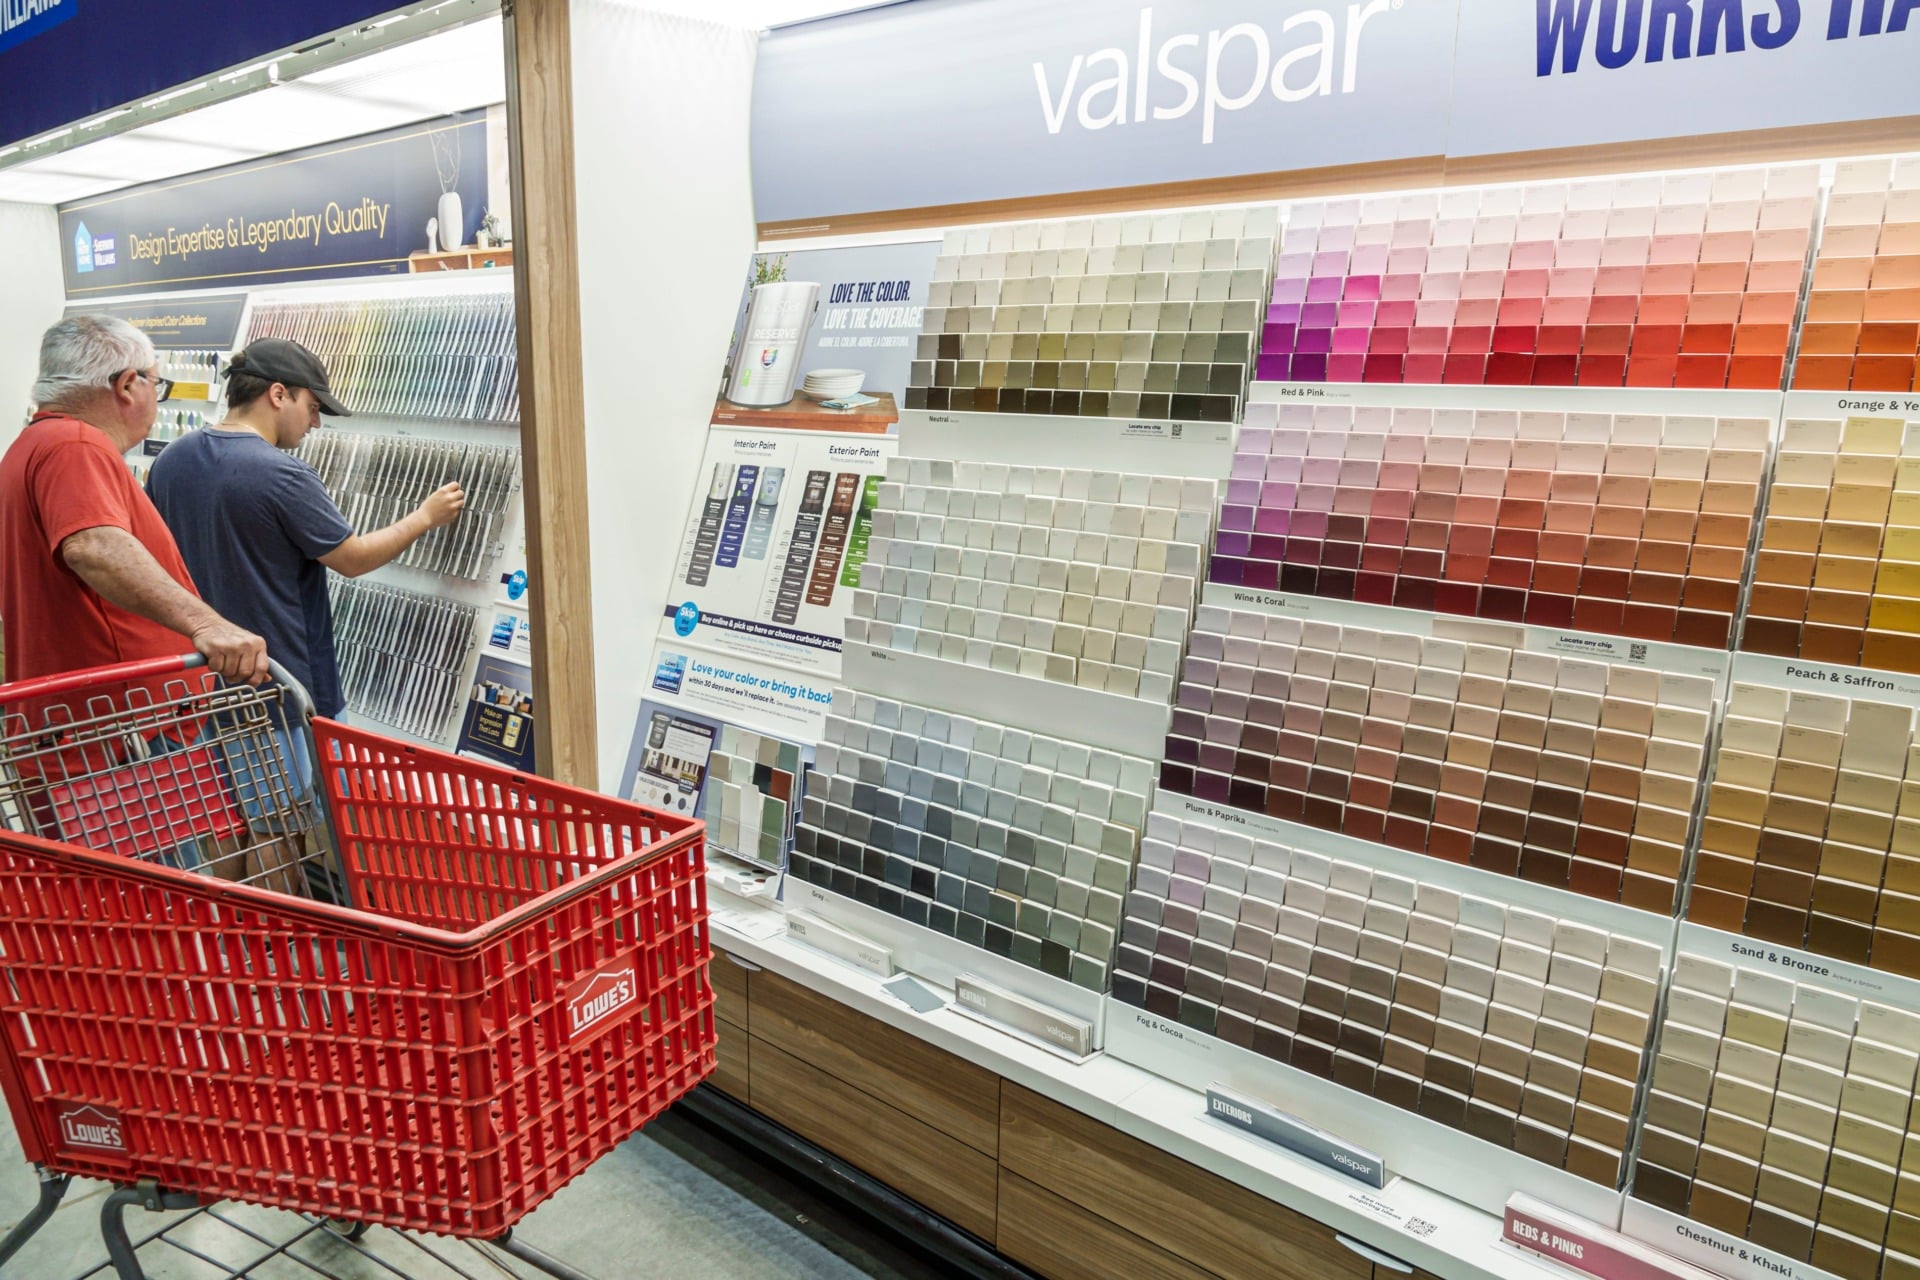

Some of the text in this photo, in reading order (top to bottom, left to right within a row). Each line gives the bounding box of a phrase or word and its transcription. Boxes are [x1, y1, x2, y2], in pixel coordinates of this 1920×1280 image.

[1032, 0, 1391, 145] valspar
[129, 232, 168, 265] Design
[168, 223, 225, 262] Expertise
[227, 217, 238, 248] &
[240, 208, 322, 253] Legendary
[325, 197, 388, 239] Quality
[829, 280, 911, 304] LOVE THE COLOR.
[823, 307, 850, 330] LOVE
[849, 306, 871, 329] THE
[869, 305, 923, 329] COVERAGE
[753, 328, 798, 340] RESERVE
[1281, 388, 1297, 396] Red
[1298, 388, 1305, 396] &
[1306, 388, 1325, 397] Pink
[1838, 399, 1885, 412] Orange
[1888, 400, 1899, 410] &
[928, 415, 949, 423] Neutral
[734, 440, 777, 450] Interior Paint
[829, 445, 880, 457] Exterior Paint
[1234, 592, 1254, 603] Wine
[1255, 595, 1262, 604] &
[1264, 596, 1286, 607] Coral
[680, 606, 696, 619] Skip
[701, 614, 713, 625] Buy
[733, 621, 746, 630] pick
[754, 625, 768, 635] here
[774, 629, 796, 640] choose
[688, 677, 704, 686] within
[703, 679, 711, 687] 30
[711, 682, 724, 692] days
[724, 686, 735, 694] and
[748, 691, 769, 703] replace
[691, 660, 833, 705] Love your color or bring it back
[1786, 666, 1826, 681] Peach
[1829, 672, 1840, 683] &
[1843, 674, 1895, 691] Saffron
[1185, 802, 1246, 825] Plum & Paprika
[1731, 943, 1765, 960] Sand
[1767, 952, 1778, 963] &
[1781, 956, 1830, 976] Bronze
[572, 980, 630, 1031] LOWE'S
[1047, 1024, 1076, 1043] valspar
[1136, 1015, 1184, 1040] Fog & Cocoa
[1213, 1098, 1253, 1125] EXTERIORS
[66, 1119, 123, 1147] LOWE'S
[1331, 1151, 1372, 1176] valspar
[1512, 1219, 1539, 1241] REDS
[1540, 1231, 1550, 1246] &
[1551, 1234, 1584, 1259] PINKS
[1676, 1224, 1793, 1278] Chestnut & Khaki
